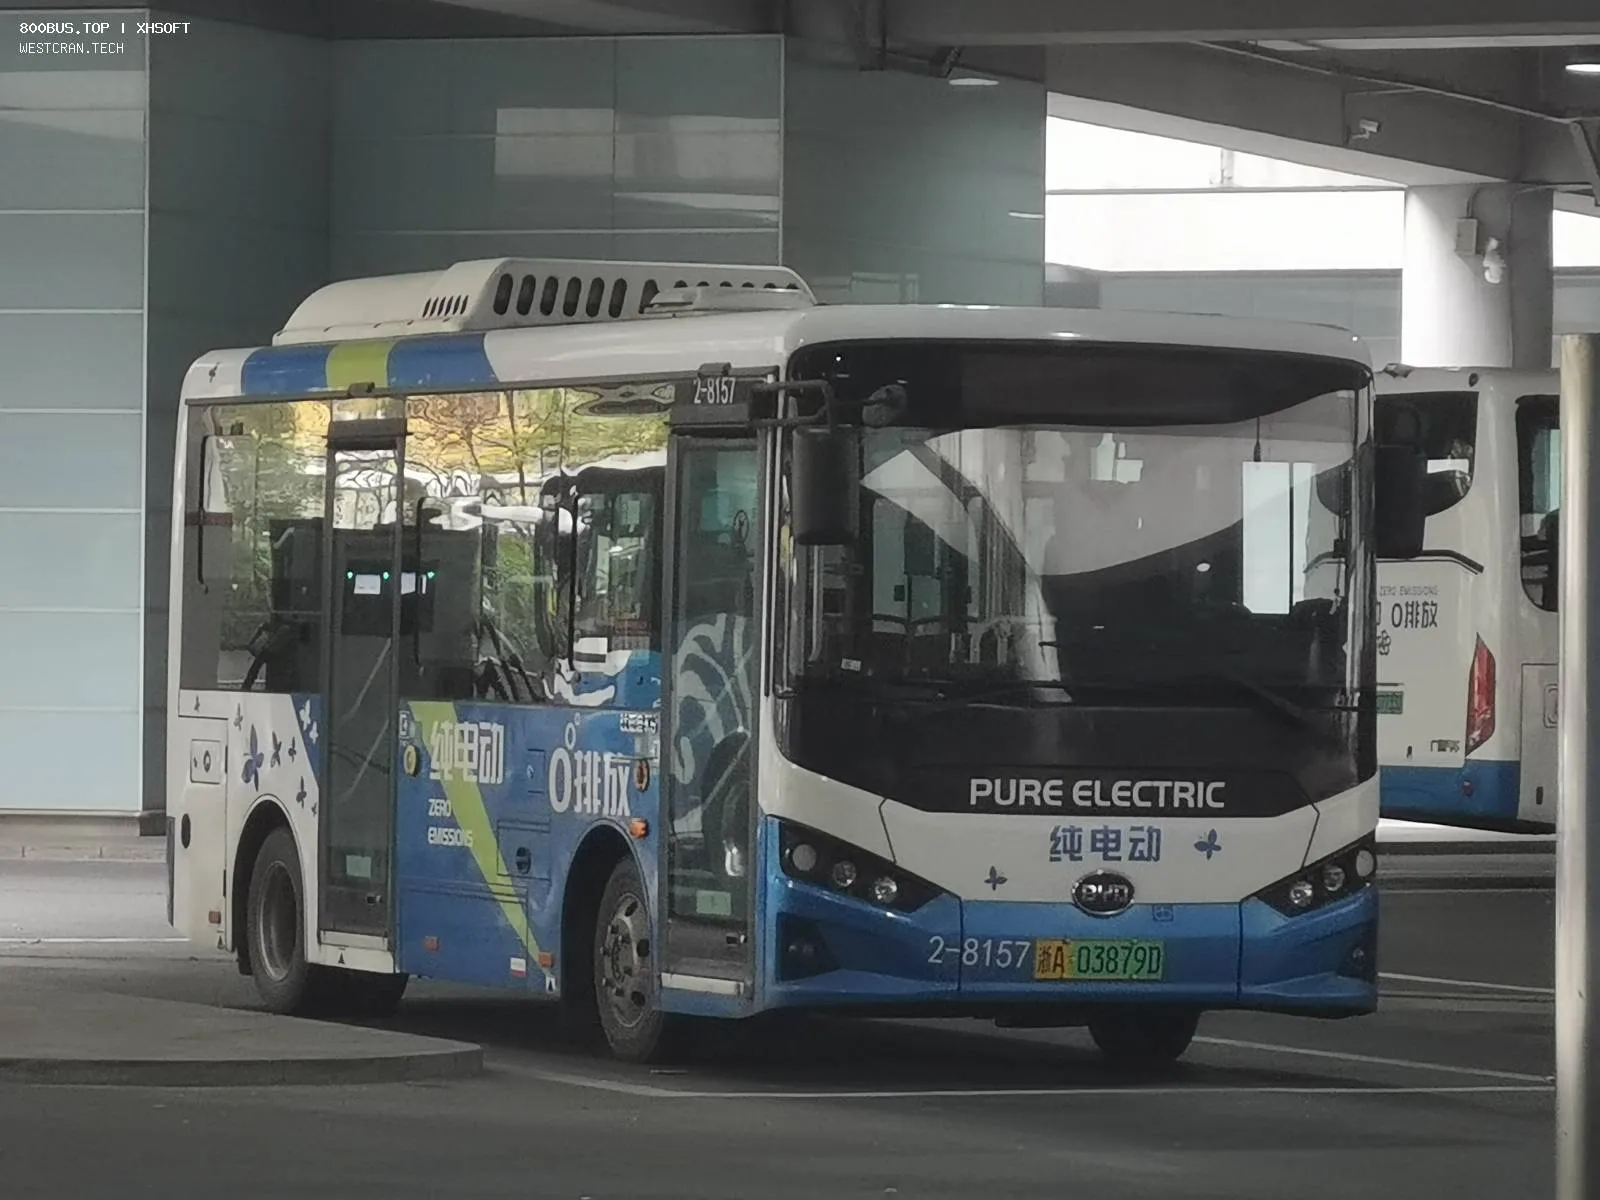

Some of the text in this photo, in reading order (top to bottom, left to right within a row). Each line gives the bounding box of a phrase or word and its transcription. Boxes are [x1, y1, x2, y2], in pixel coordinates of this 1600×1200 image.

[693, 376, 736, 404] 2-8157
[429, 720, 505, 785] 纯电动
[428, 798, 451, 817] ZERO
[970, 778, 1226, 808] PURE ELECTRIC
[1049, 824, 1161, 862] 纯电动
[927, 935, 1031, 968] 2-8157
[1077, 945, 1161, 974] 03879D
